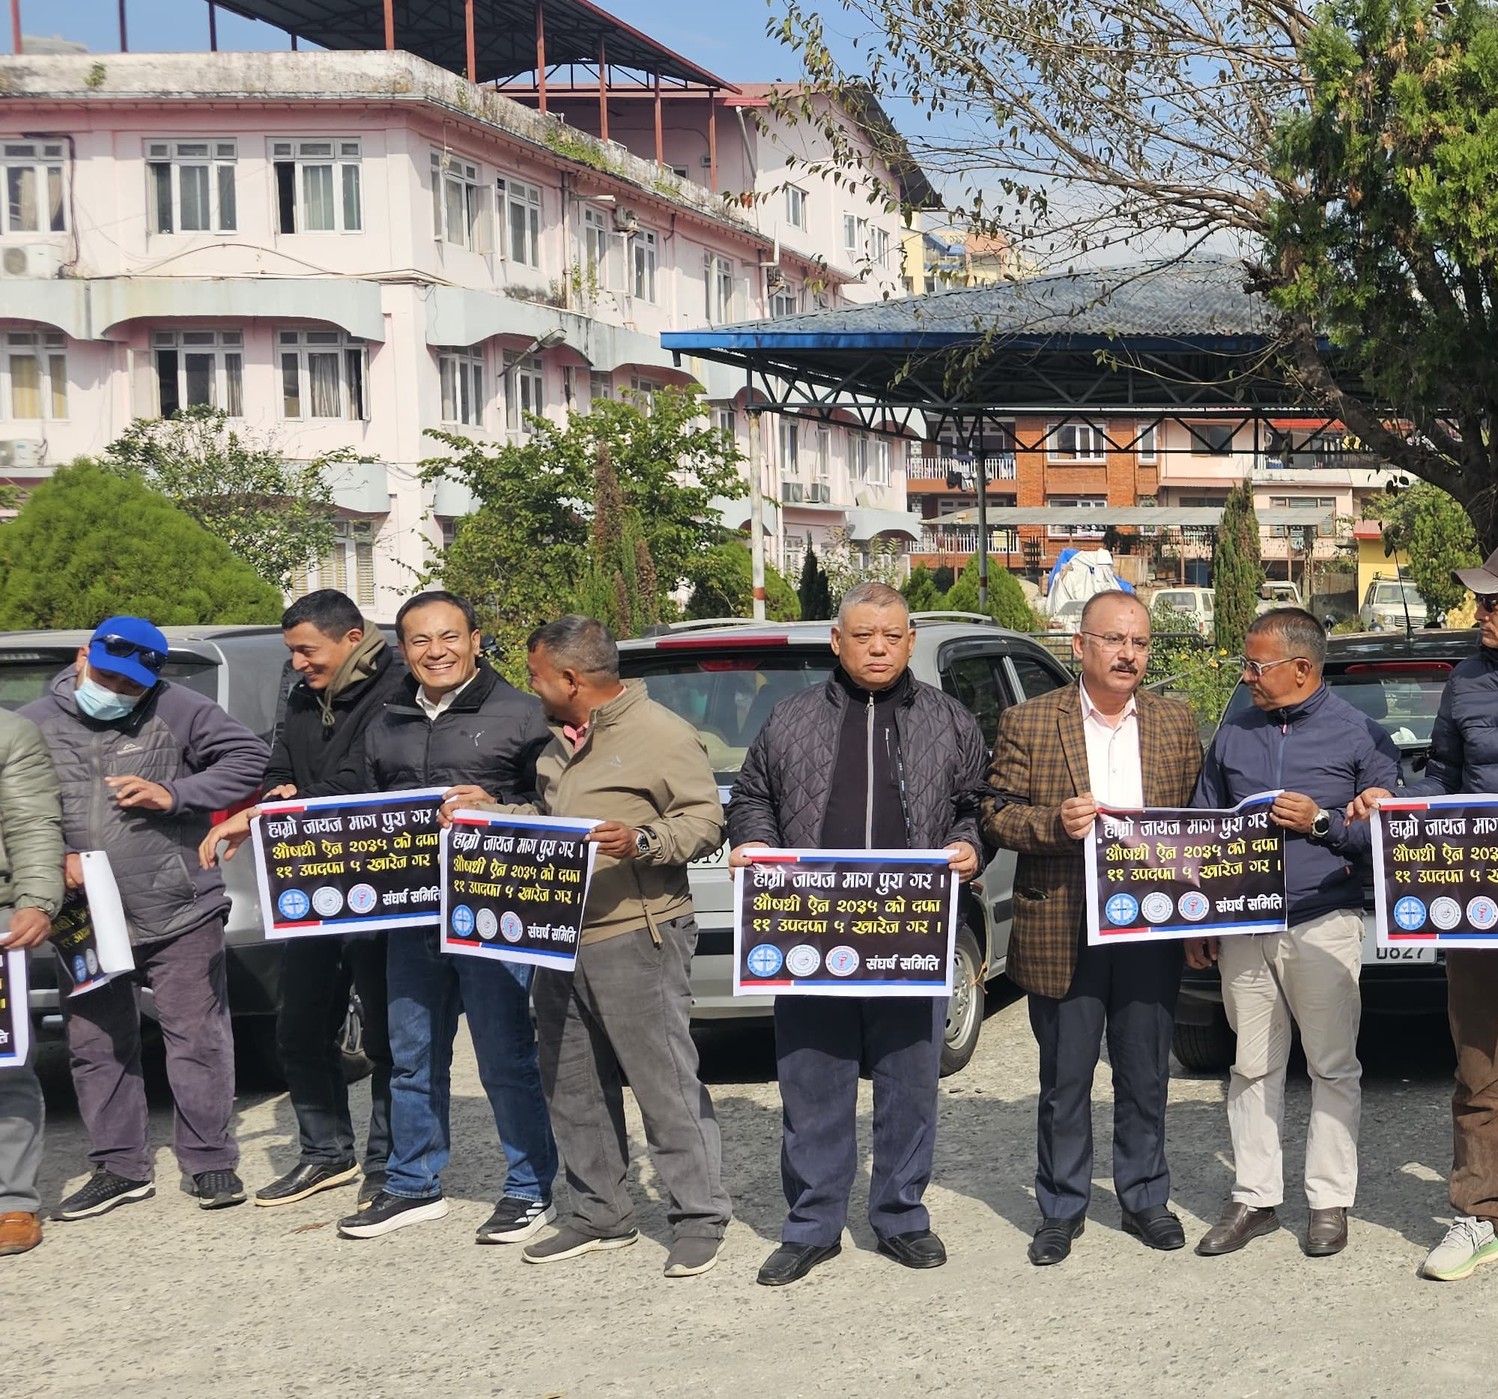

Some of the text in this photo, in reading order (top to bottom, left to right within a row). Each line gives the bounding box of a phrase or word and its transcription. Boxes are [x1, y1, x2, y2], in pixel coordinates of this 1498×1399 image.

[267, 815, 297, 838] हाम्रो
[302, 817, 342, 834] जायज
[348, 814, 377, 830] माग
[382, 812, 406, 833] पुरा
[1104, 816, 1134, 841] हाम्रो
[1140, 820, 1180, 836] जायज
[1187, 819, 1215, 834] माग
[1219, 816, 1244, 839] पुरा
[1388, 814, 1419, 839] हाम्रो
[1425, 819, 1466, 835] जायज
[273, 832, 438, 859] औषधी ऐन २०३५ को दफा
[453, 828, 481, 851] हाम्रो
[484, 835, 514, 852] जायज
[517, 838, 538, 854] माग
[536, 840, 557, 862] पुरा
[1106, 838, 1278, 863] औषधी ऐन २०३५ को दफा
[1393, 843, 1435, 861] औषधी
[1442, 843, 1463, 864] ऐन
[276, 866, 292, 878] ११
[299, 862, 344, 876] उपदफा
[351, 859, 359, 872] ५
[366, 853, 407, 871] खारेज
[454, 855, 580, 882] औषधी ऐन २०३५ को दफा
[1108, 869, 1124, 881] ११
[1130, 864, 1178, 881] उपदफा
[1183, 866, 1192, 879] ५
[1199, 859, 1243, 879] खारेज
[1395, 871, 1410, 883] ११
[1417, 870, 1463, 884] उपदफा
[1470, 869, 1480, 882] ५
[454, 880, 464, 892] ११
[469, 881, 501, 896] उपदफा
[505, 885, 513, 898] ५
[518, 883, 549, 901] खारेज
[754, 866, 785, 890] हाम्रो
[792, 872, 836, 889] जायज
[843, 873, 873, 888] माग
[876, 873, 904, 895] पुरा
[383, 888, 409, 905] संघर्ष
[411, 885, 441, 903] समिति
[753, 893, 941, 915] औषधी ऐन २०३५ को दफा
[1216, 895, 1245, 912] संघर्ष
[1247, 893, 1282, 910] समिति
[527, 923, 551, 939] संघर्ष
[552, 925, 576, 943] समिति
[753, 919, 770, 931] ११
[778, 919, 828, 933] उपदफा
[834, 921, 844, 933] ५
[852, 916, 900, 934] खारेज
[866, 954, 898, 970] संघर्ष
[900, 954, 940, 970] समिति
